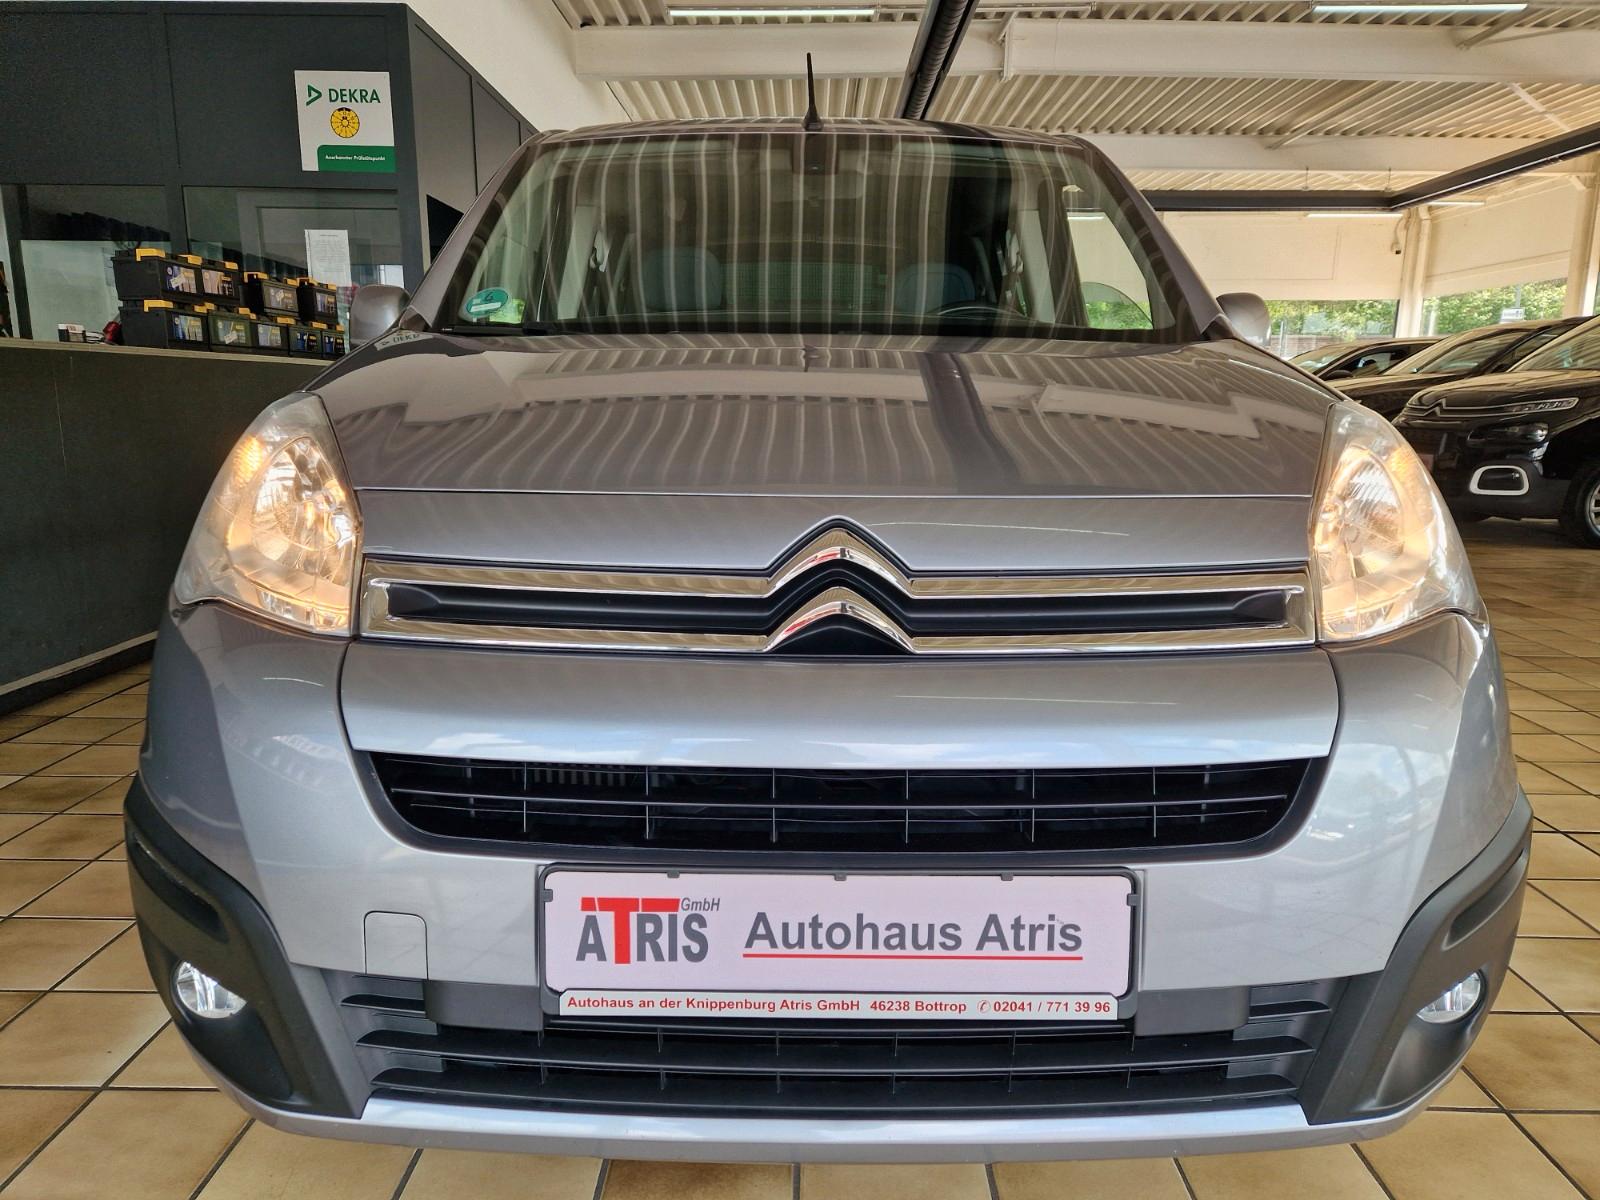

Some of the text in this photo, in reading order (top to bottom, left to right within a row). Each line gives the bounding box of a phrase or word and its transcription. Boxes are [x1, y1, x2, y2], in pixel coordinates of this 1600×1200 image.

[328, 88, 381, 104] DEKRA
[575, 896, 721, 964] ATRIS GmbH
[744, 911, 1083, 952] Autohaus Atris
[567, 996, 634, 1009] Autohaus
[638, 998, 655, 1009] an
[660, 998, 682, 1009] der
[685, 998, 776, 1013] Knippenburg
[780, 999, 813, 1011] Atris
[816, 1000, 860, 1011] GmbH
[870, 1000, 910, 1012] 46238
[914, 1000, 967, 1014] Bottrop
[993, 1001, 1033, 1013] 02041
[1046, 1001, 1069, 1012] 771
[1074, 1001, 1090, 1013] 39
[1094, 1001, 1111, 1013] 96
